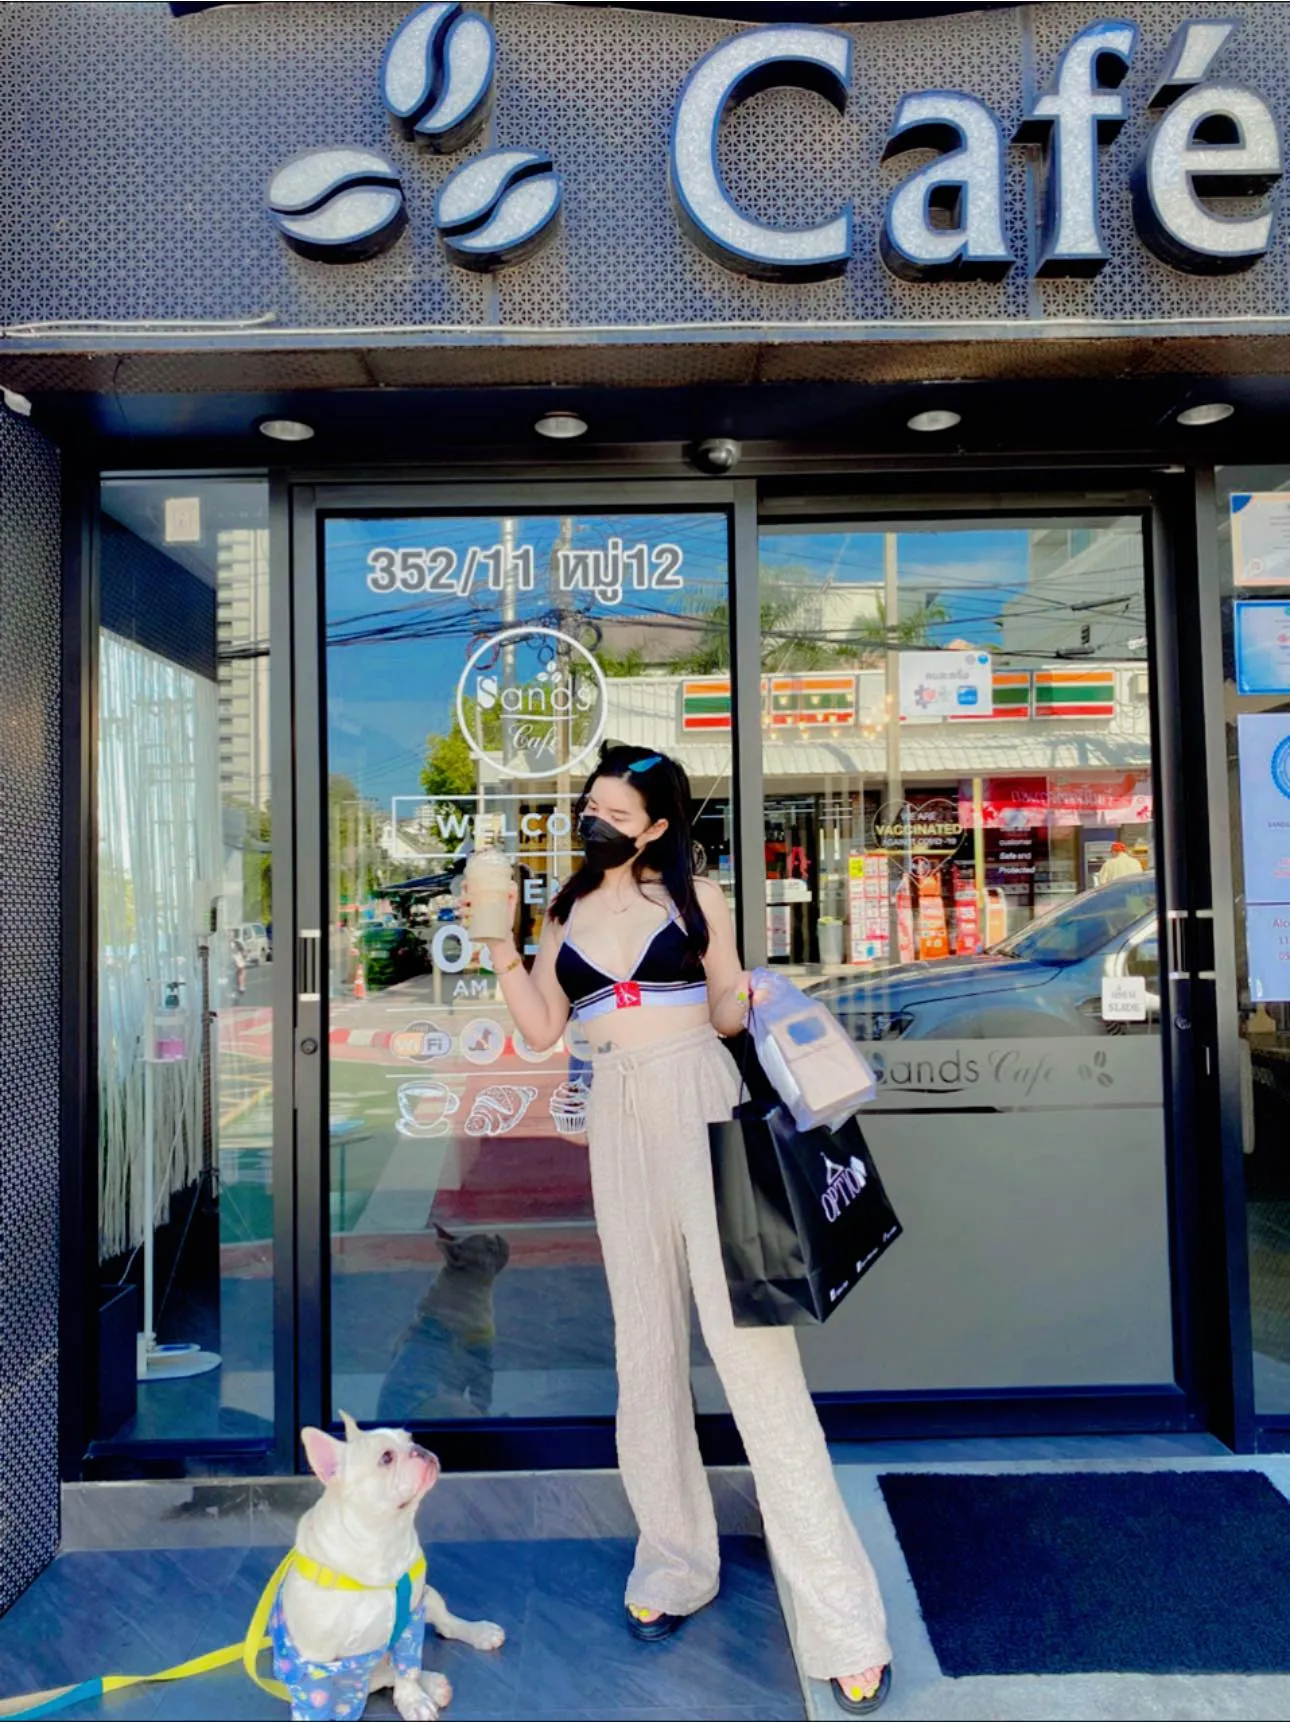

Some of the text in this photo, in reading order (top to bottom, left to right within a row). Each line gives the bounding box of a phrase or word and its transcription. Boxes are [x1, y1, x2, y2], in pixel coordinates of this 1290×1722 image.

[669, 18, 1283, 272] Café
[366, 544, 535, 597] 352/11
[476, 675, 592, 711] Sands
[436, 812, 574, 839] WELCO
[875, 823, 963, 836] VACCINATED
[452, 978, 489, 997] AM
[1107, 1001, 1141, 1013] SLIDE
